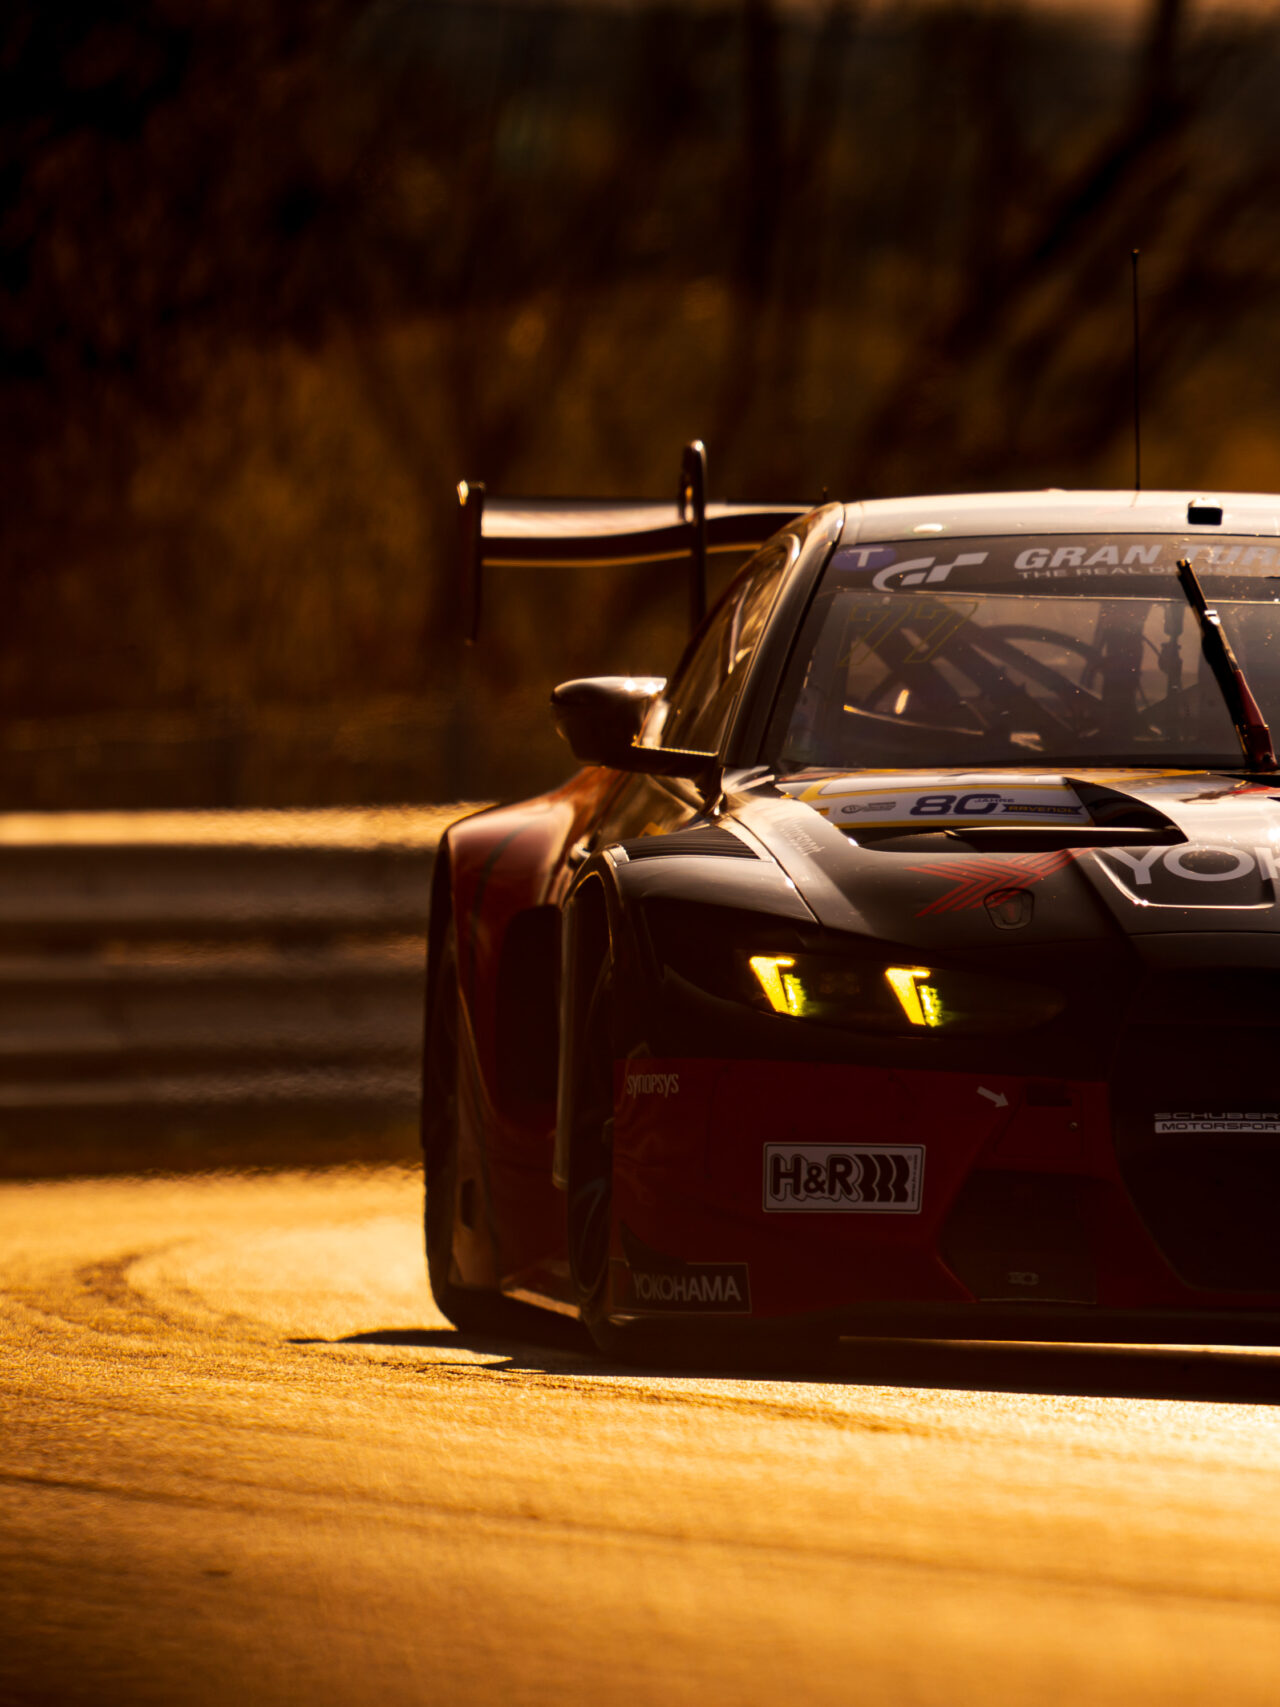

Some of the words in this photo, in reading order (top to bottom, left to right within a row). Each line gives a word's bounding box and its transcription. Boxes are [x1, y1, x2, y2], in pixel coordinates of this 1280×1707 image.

[1014, 545, 1162, 570] GRAN
[1017, 569, 1067, 579] THE
[1076, 565, 1138, 576] REAL
[909, 793, 1001, 815] 80
[626, 1073, 680, 1099] SYNOPSYS
[771, 1155, 856, 1199] H&R
[633, 1273, 742, 1302] YOKOHAMA
